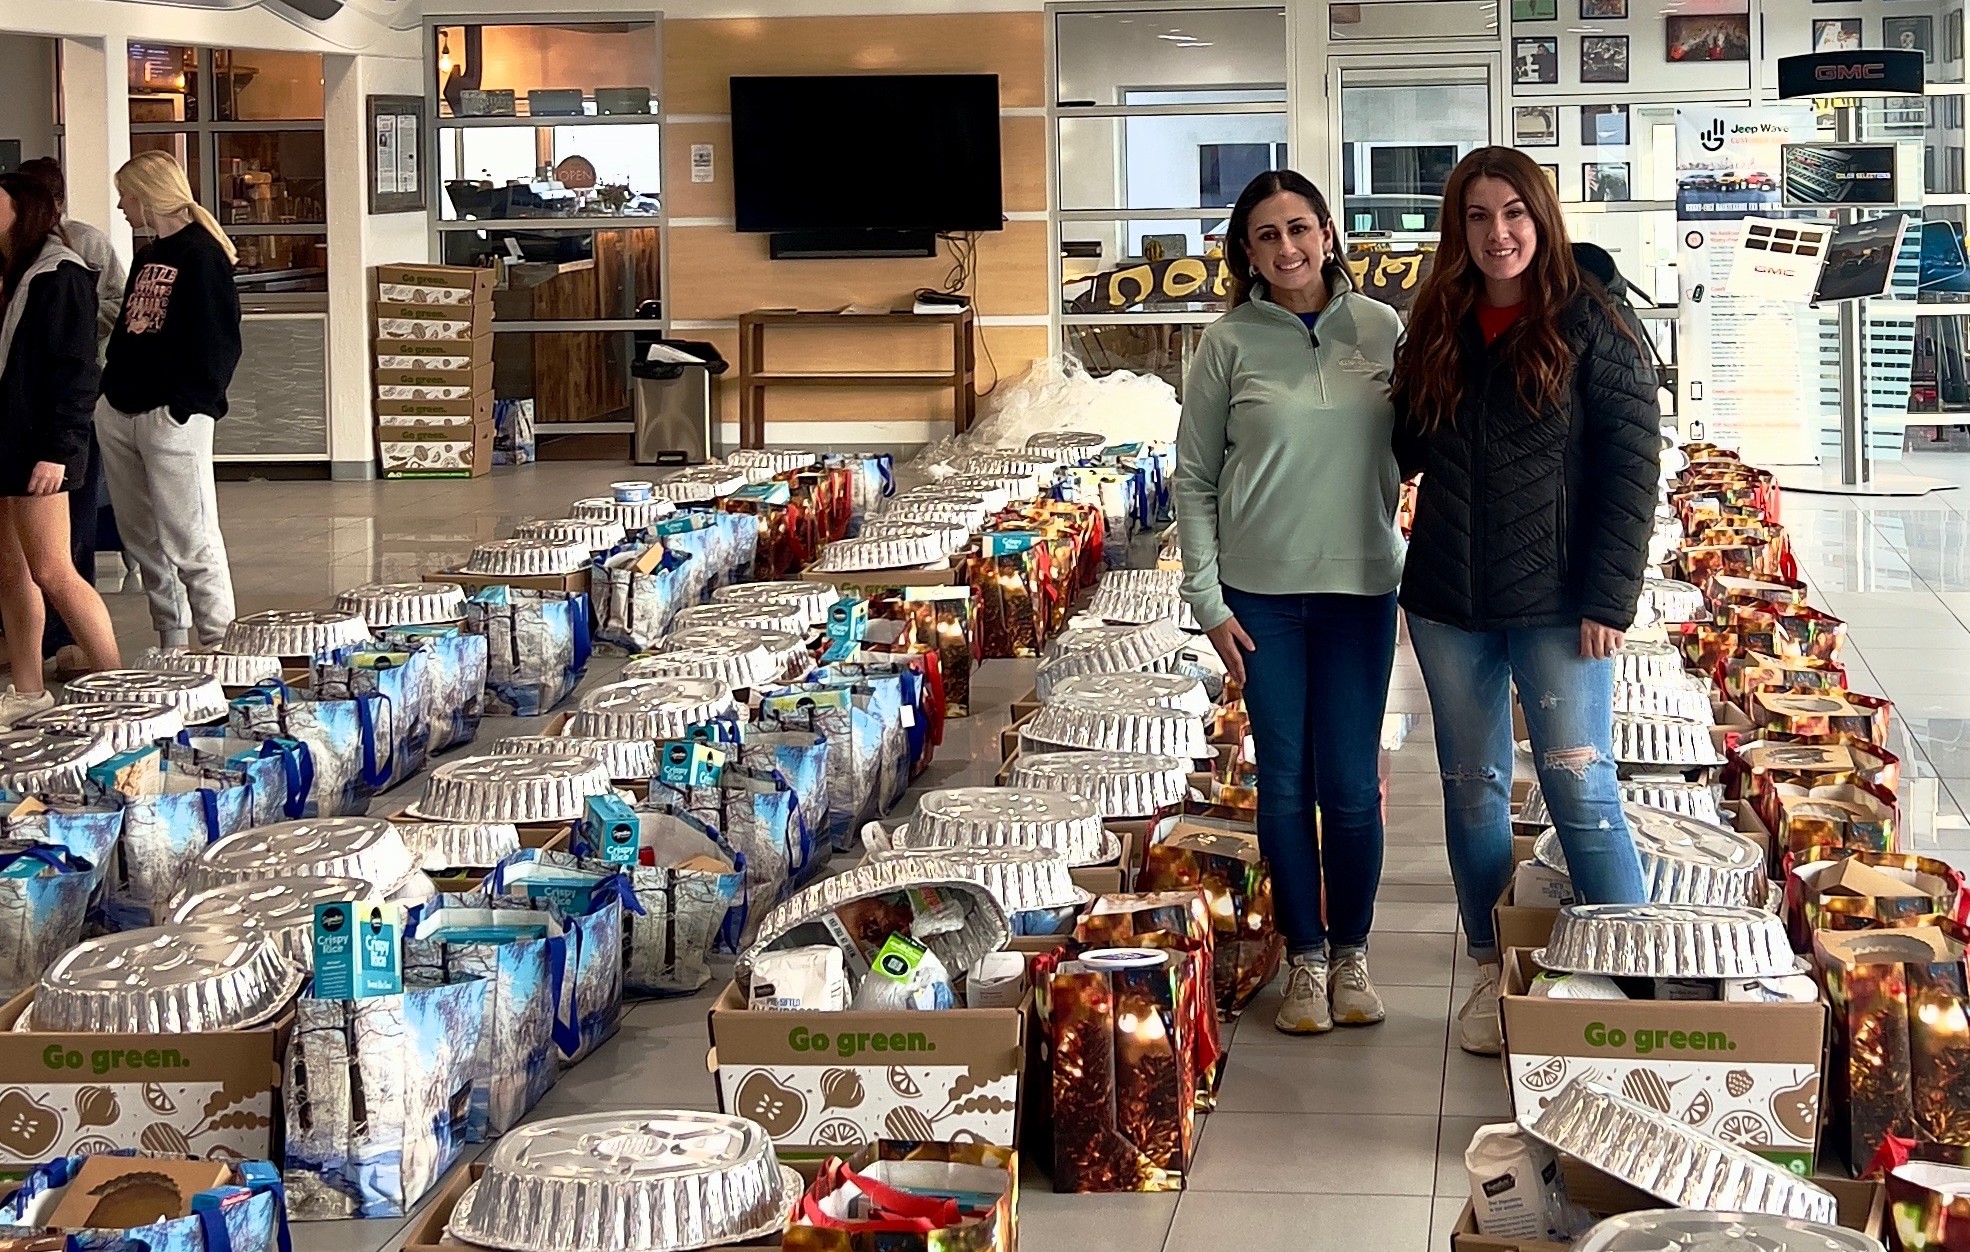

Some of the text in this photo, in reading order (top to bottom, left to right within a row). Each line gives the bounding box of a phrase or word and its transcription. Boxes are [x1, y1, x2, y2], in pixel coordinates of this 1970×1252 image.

[1815, 63, 1884, 81] GMC
[1731, 123, 1789, 134] Jeep Wave
[560, 170, 593, 181] OPEN
[1754, 265, 1796, 277] GMC
[402, 274, 448, 285] Go green.
[401, 308, 447, 318] Go green.
[400, 345, 447, 354] Go green.
[401, 375, 447, 385] Go green.
[401, 405, 447, 414] Go green.
[402, 431, 448, 440] Go green.
[664, 765, 688, 776] Crispy
[607, 845, 635, 856] Crispy
[544, 887, 576, 900] Crispy
[317, 934, 349, 945] Crispy
[322, 944, 344, 954] Rice
[365, 935, 390, 957] Crispy
[788, 1026, 936, 1057] Go green.
[1584, 1022, 1737, 1054] Go green.
[43, 1044, 190, 1075] Go green.
